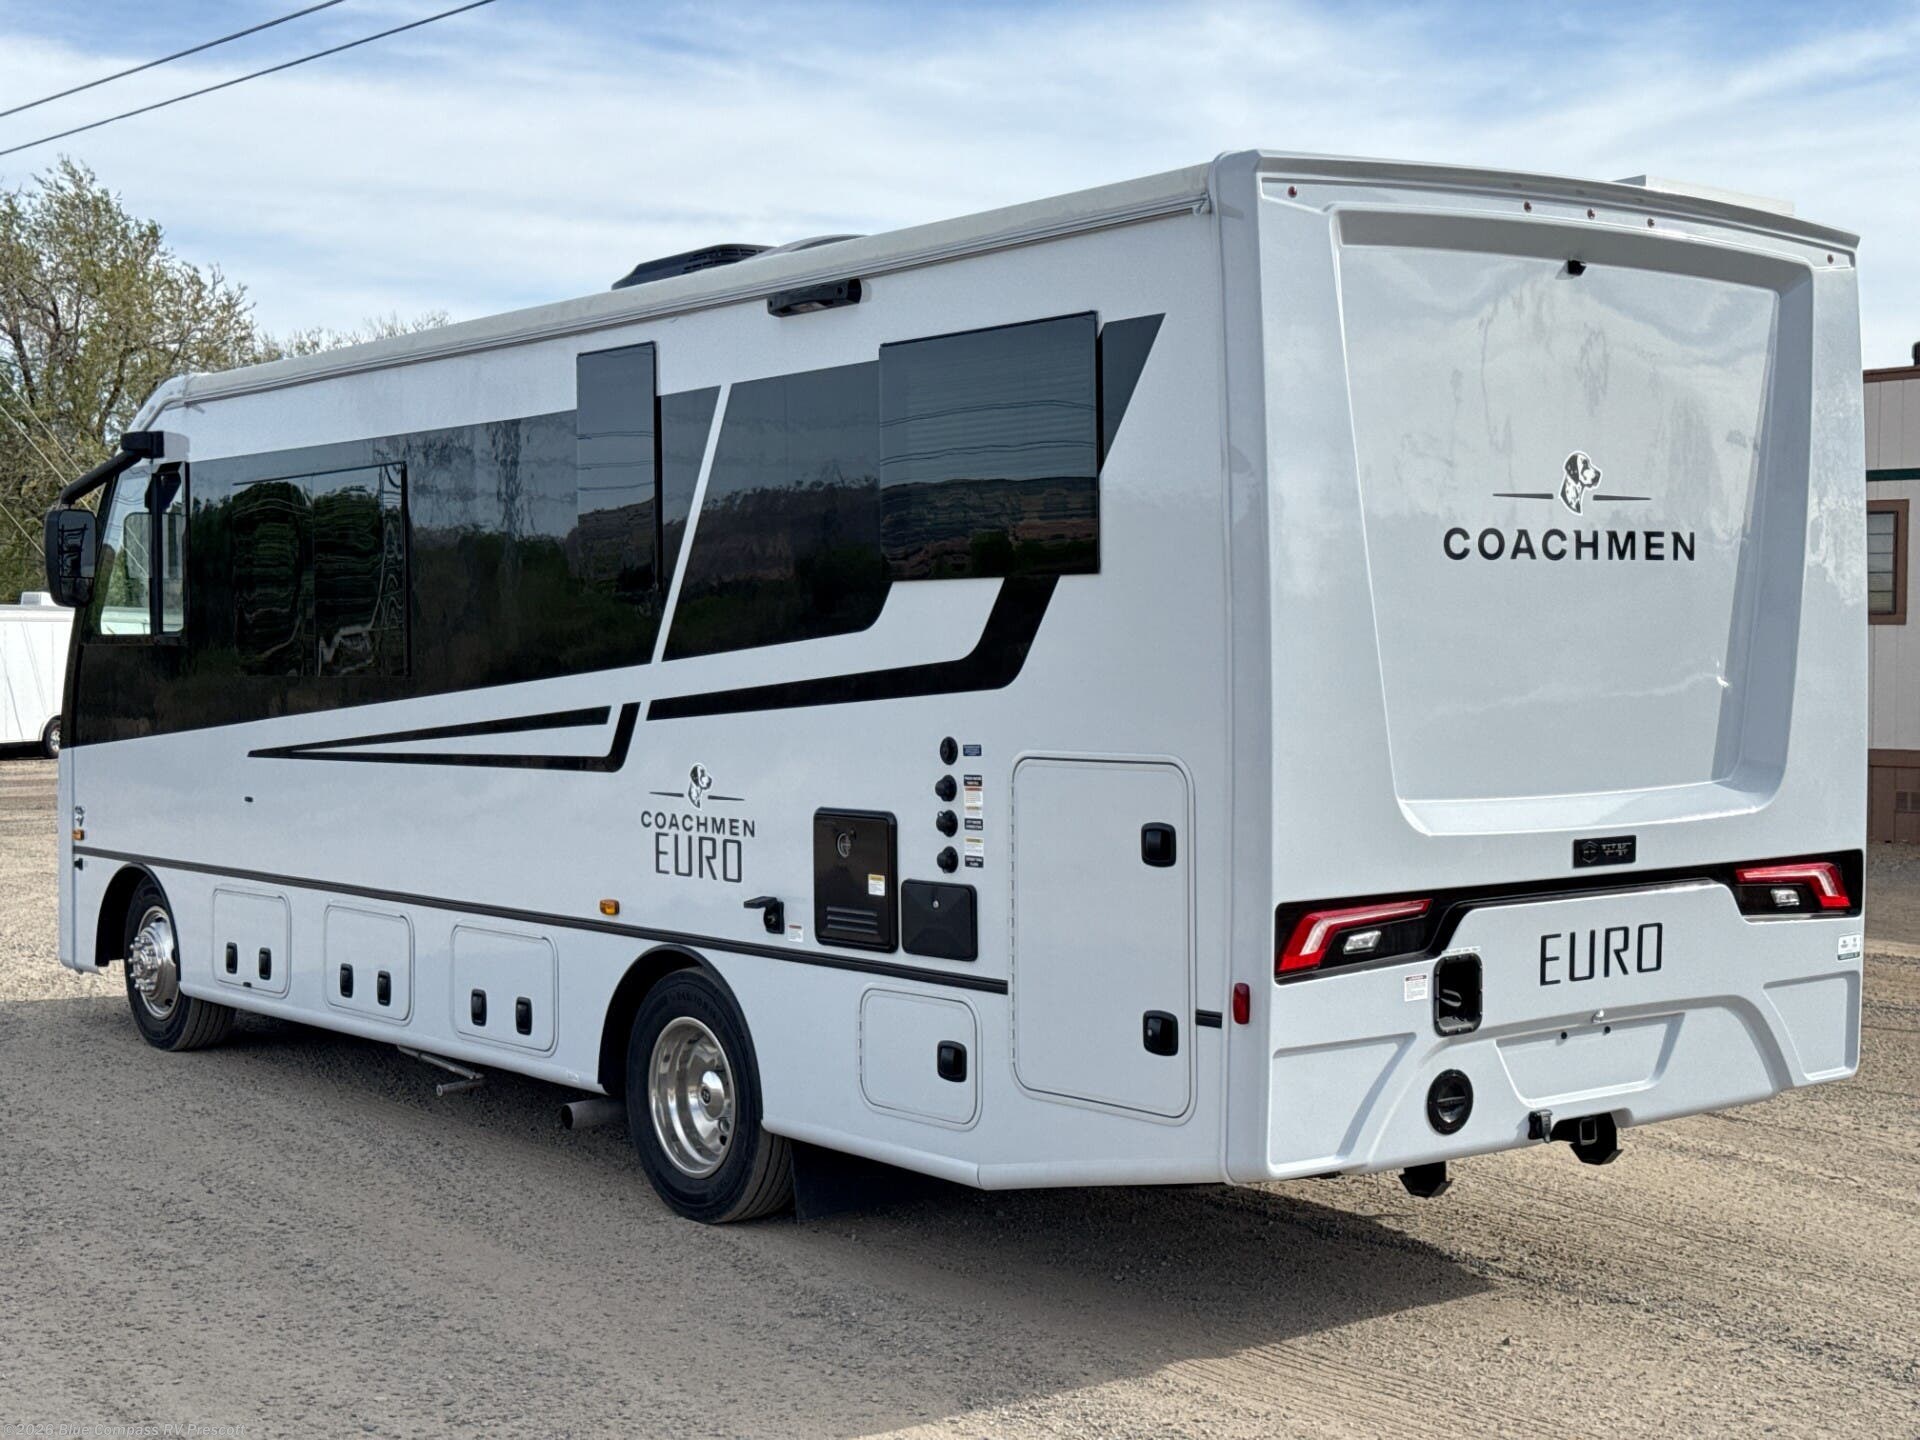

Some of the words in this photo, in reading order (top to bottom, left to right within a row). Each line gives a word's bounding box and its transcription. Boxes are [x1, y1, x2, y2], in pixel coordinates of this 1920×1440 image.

[1443, 527, 1695, 561] COACHMEN
[641, 810, 755, 838] COACHMEN
[655, 832, 742, 883] EURO
[1540, 922, 1663, 986] EURO
